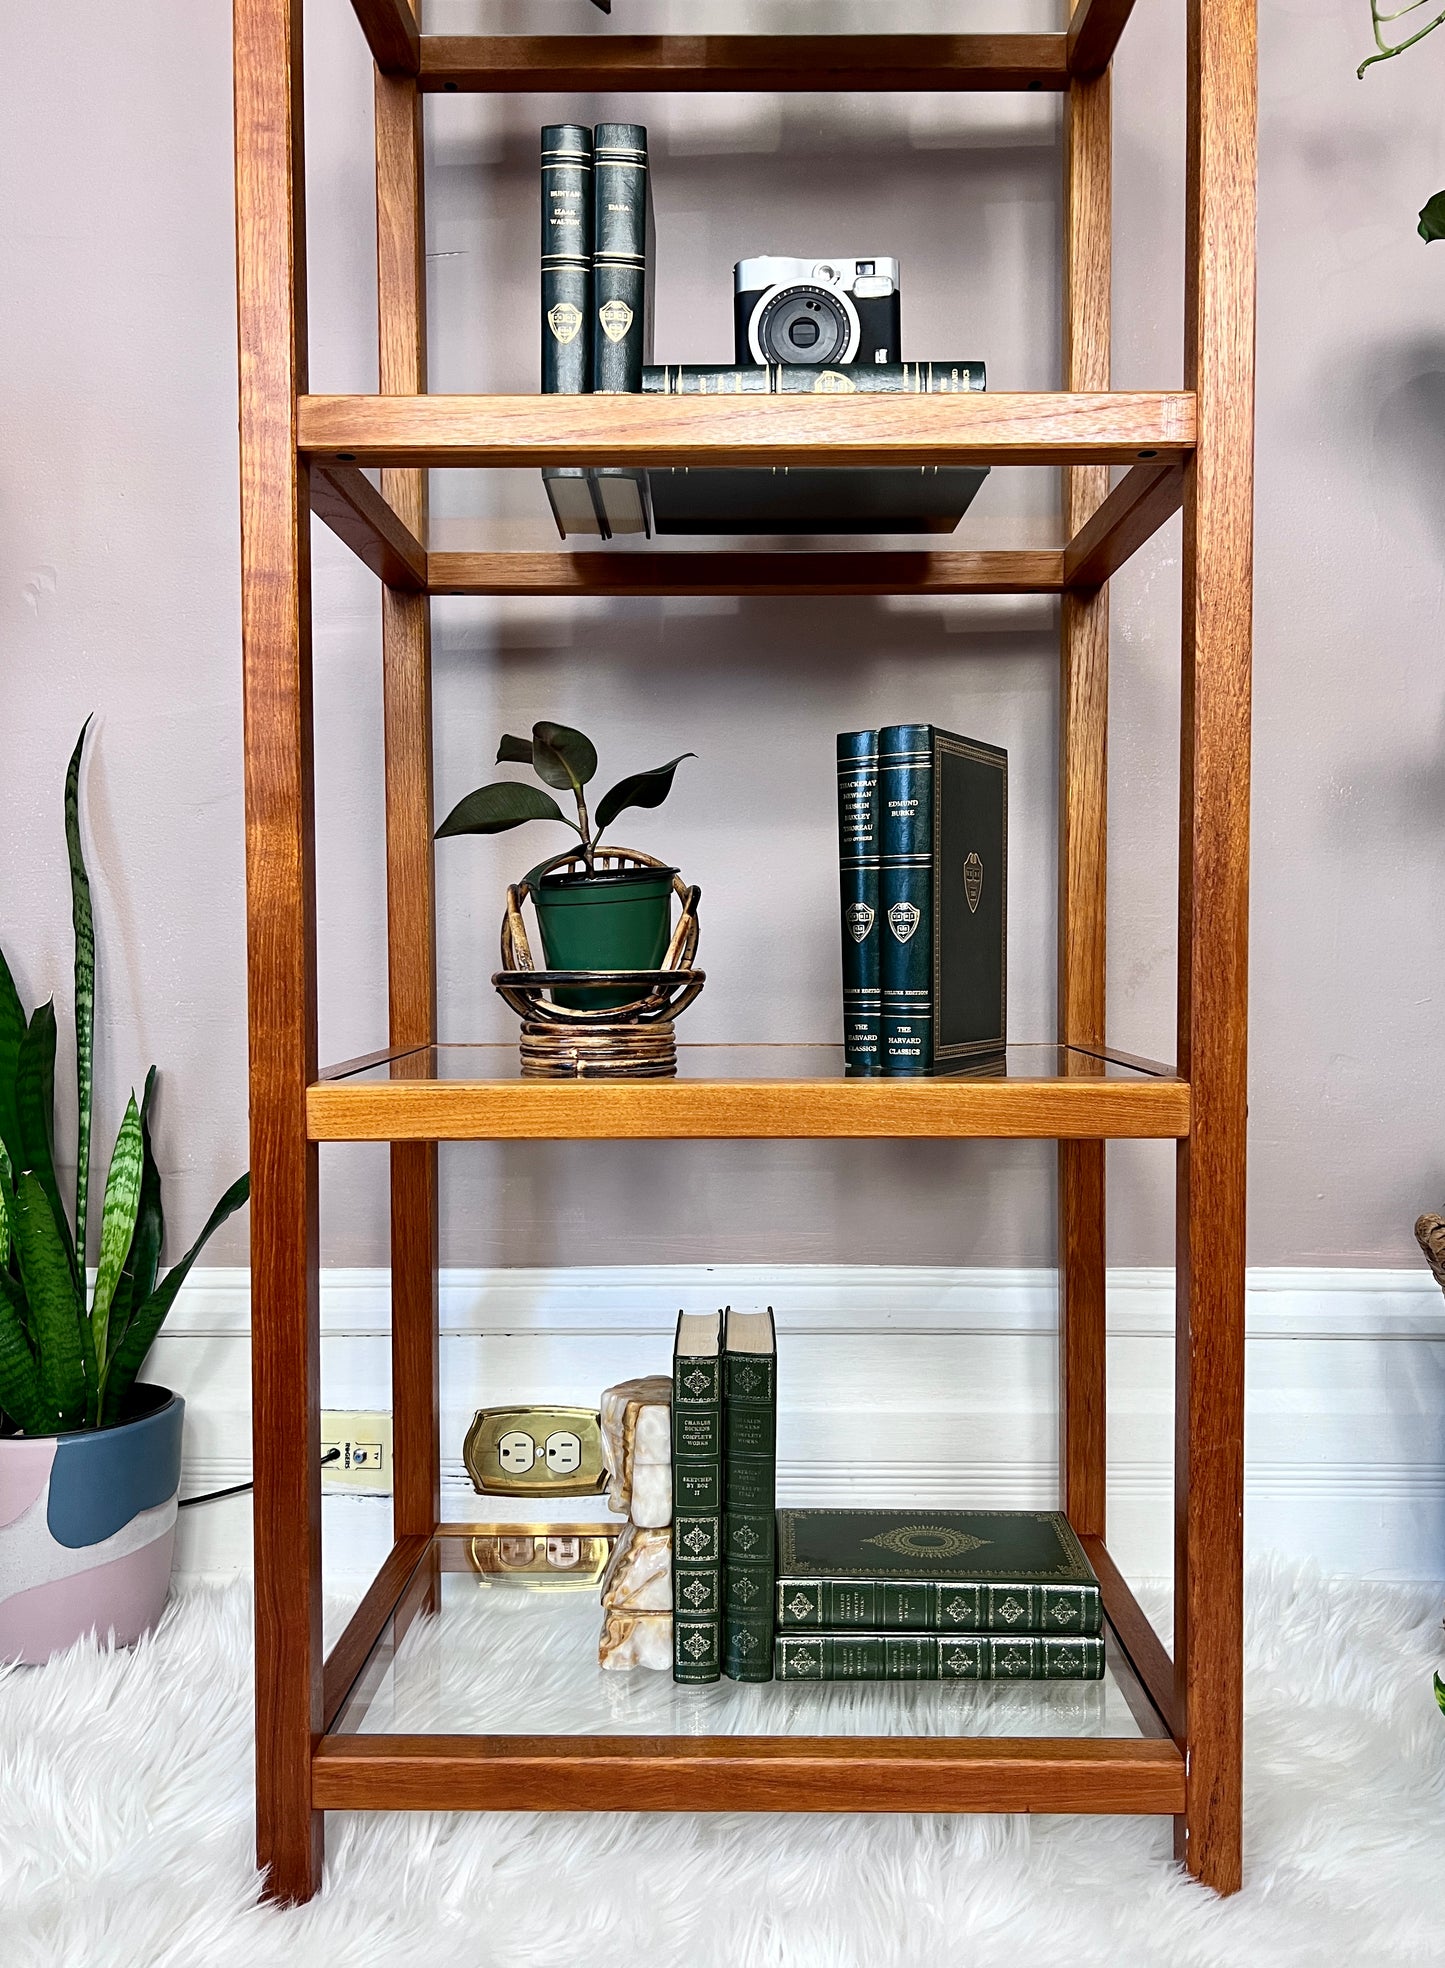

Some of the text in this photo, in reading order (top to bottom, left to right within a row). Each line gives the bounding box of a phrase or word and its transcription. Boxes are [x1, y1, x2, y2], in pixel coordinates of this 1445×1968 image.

[550, 190, 581, 198] BUNYAN
[839, 780, 877, 789] THACKERAY
[888, 799, 919, 808] EDMUND
